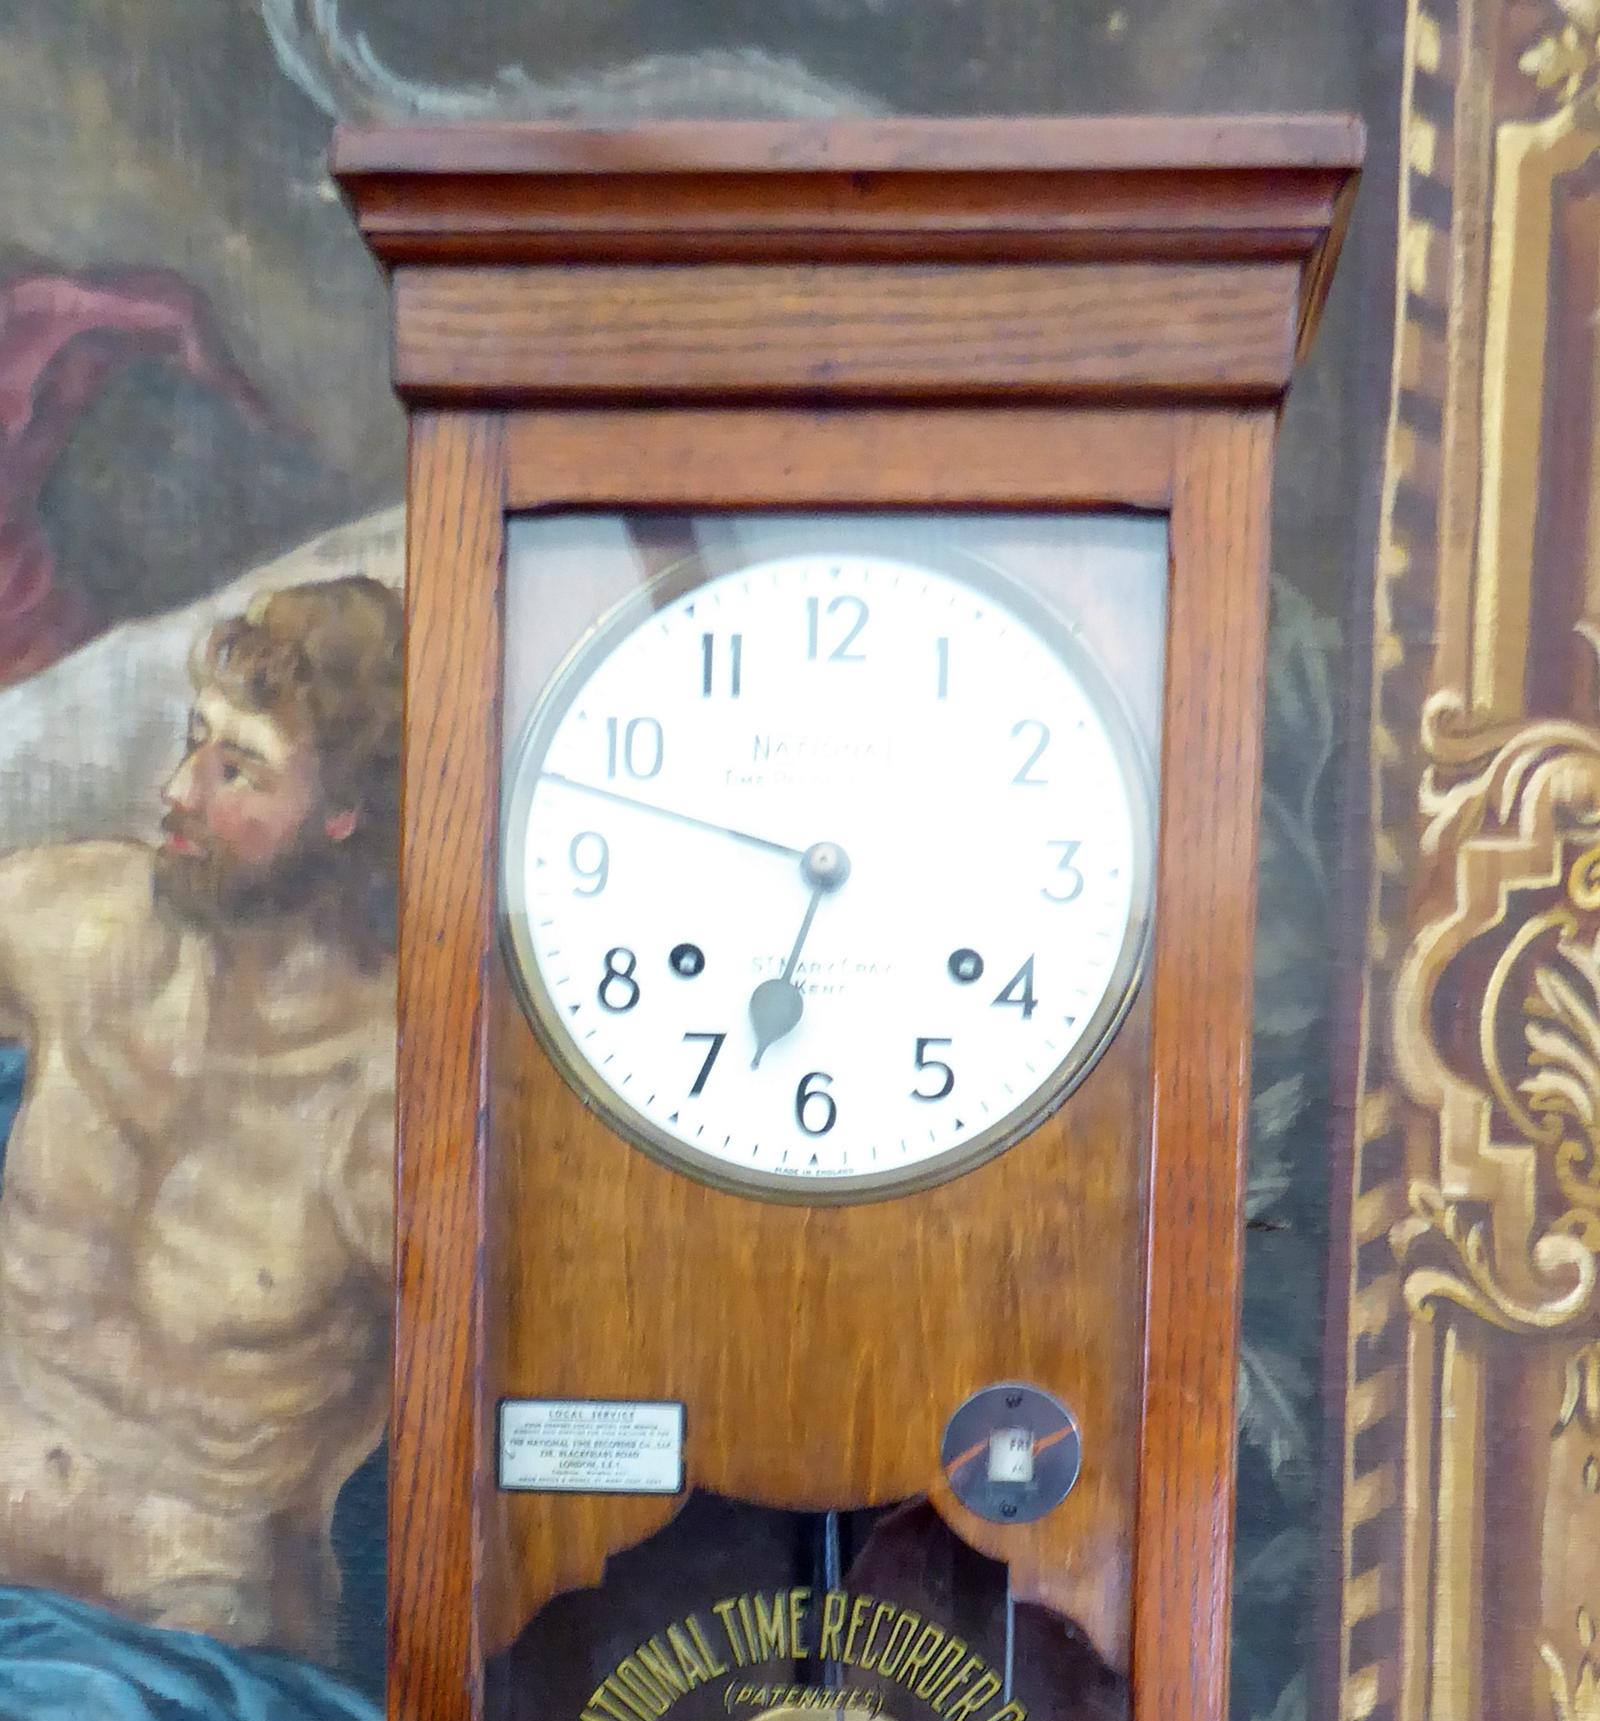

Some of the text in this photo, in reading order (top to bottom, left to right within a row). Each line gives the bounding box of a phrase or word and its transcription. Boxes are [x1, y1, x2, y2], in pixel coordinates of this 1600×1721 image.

[804, 593, 871, 663] 12
[700, 632, 744, 699] 11
[936, 636, 950, 700] 1
[605, 715, 666, 781] 10
[1008, 718, 1052, 786] 2
[568, 830, 611, 898] 9
[1040, 839, 1086, 903] 3
[596, 945, 642, 1015] 8
[990, 952, 1040, 1021] 4
[681, 1031, 728, 1099] 7
[908, 1037, 955, 1102] 5
[794, 1071, 838, 1137] 6
[712, 1585, 812, 1668] TIME
[723, 1680, 885, 1721] (PATENTEES)
